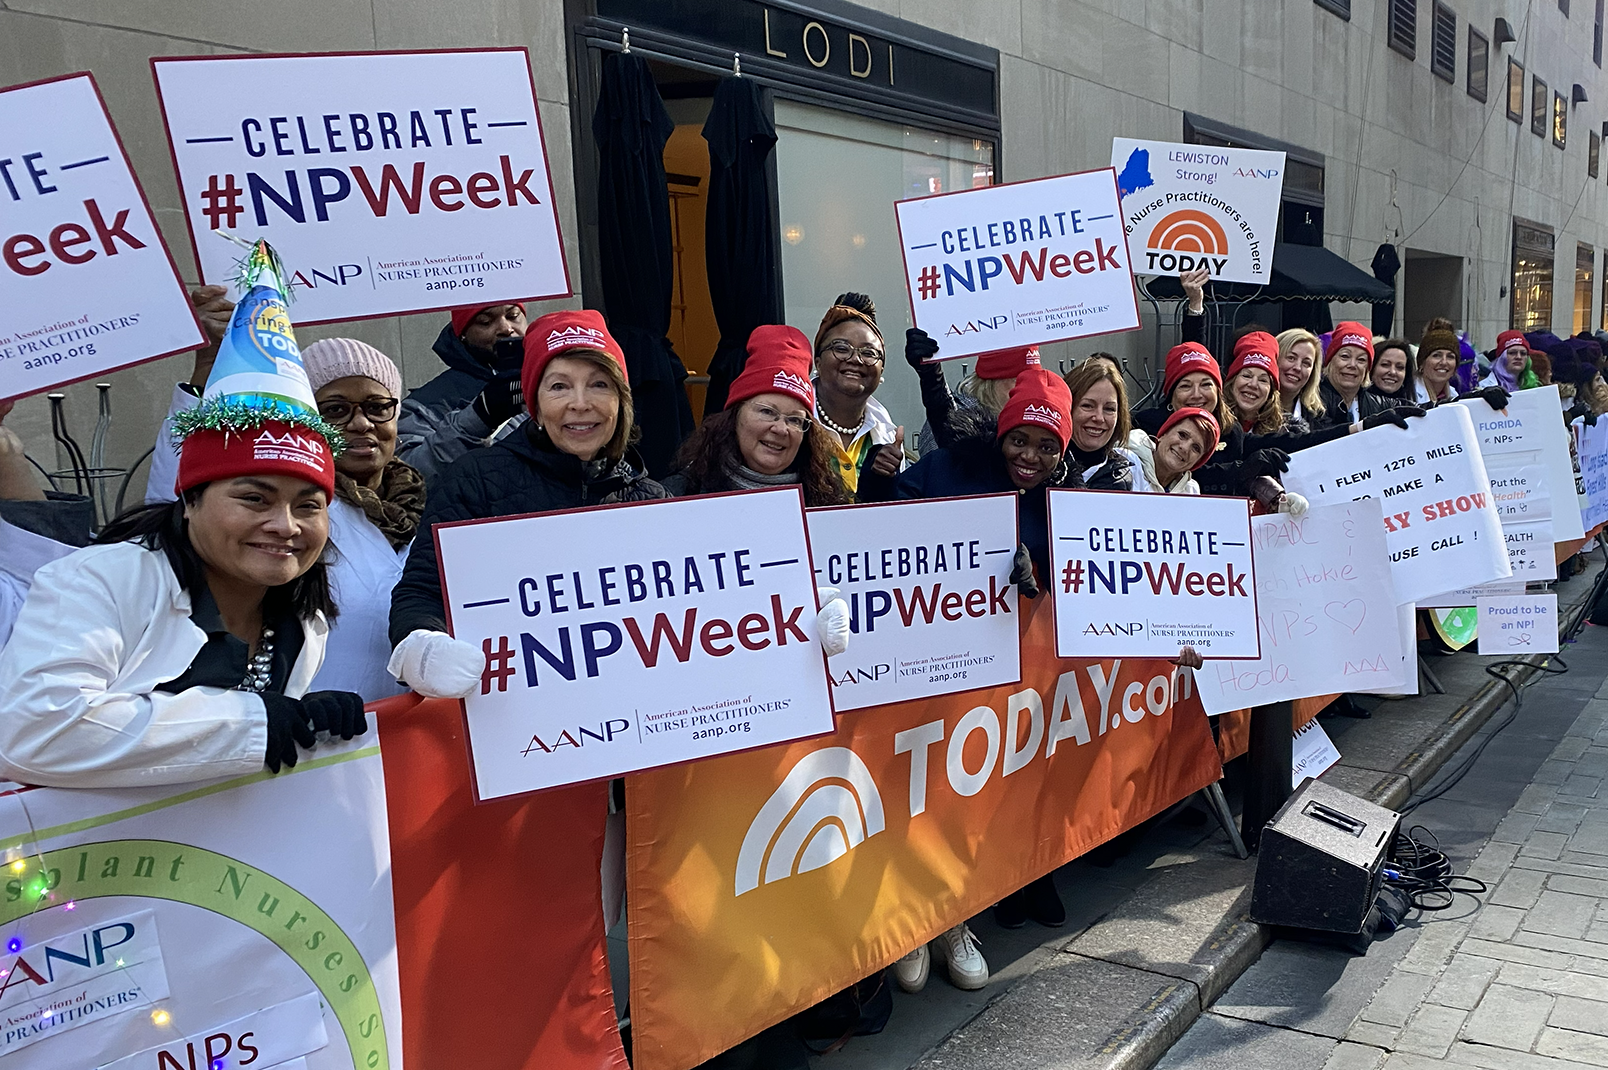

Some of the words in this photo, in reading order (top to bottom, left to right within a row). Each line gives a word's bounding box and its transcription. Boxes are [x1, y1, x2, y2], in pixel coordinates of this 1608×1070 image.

[764, 8, 894, 86] LODI
[241, 108, 483, 158] CELEBRATE
[1168, 151, 1230, 166] LEWISTON
[1175, 169, 1218, 185] Strong!
[1232, 168, 1279, 180] AANP
[201, 155, 541, 230] #NPWeek
[940, 209, 1085, 255] CELEBRATE
[1130, 197, 1164, 226] Nurse
[1166, 191, 1242, 222] Practitioners
[1239, 220, 1255, 240] are
[1250, 241, 1263, 275] here!
[376, 258, 421, 270] American
[423, 253, 470, 265] Association
[473, 252, 485, 261] of
[917, 237, 1122, 301] #NPWeek
[1145, 252, 1229, 276] TODAY
[286, 264, 363, 289] ANP
[378, 267, 422, 282] NURSE
[426, 276, 485, 291] aanp.org
[1016, 310, 1043, 319] American
[1045, 303, 1076, 314] Association
[1016, 316, 1043, 326] NURSE
[14, 319, 76, 342] Association
[78, 314, 89, 325] of
[546, 326, 605, 342] AANP
[945, 315, 1008, 337] AANP
[1045, 318, 1083, 331] aanp.org
[23, 342, 97, 370] aanp.org
[1024, 403, 1062, 420] AANP
[1479, 418, 1523, 431] FLORIDA
[253, 430, 324, 454] AANP
[1494, 435, 1513, 444] NPs
[1319, 484, 1325, 493] I
[1335, 469, 1372, 488] FLEW
[1383, 455, 1416, 473] 1276
[1426, 443, 1464, 460] MILES
[1383, 478, 1424, 498] MAKE
[1435, 473, 1444, 483] A
[1490, 478, 1508, 488] Put
[1510, 477, 1527, 486] the
[1422, 492, 1487, 522] SHOW
[1507, 505, 1516, 514] in
[1088, 527, 1219, 556] CELEBRATE
[1431, 534, 1464, 551] CALL
[828, 540, 981, 585] CELEBRATE
[518, 549, 756, 618] CELEBRATE
[1061, 559, 1248, 597] #NPWeek
[1294, 564, 1358, 588] Hokie
[1488, 605, 1519, 615] Proud
[1521, 605, 1532, 615] to
[1534, 605, 1547, 615] be
[1082, 622, 1143, 636] AANP
[1501, 622, 1514, 630] an
[1516, 620, 1535, 629] NP!
[480, 593, 810, 696] #NPWeek
[900, 658, 929, 667] American
[930, 652, 963, 663] Association
[900, 666, 928, 677] NURSE
[929, 669, 968, 683] aanp.org
[1215, 655, 1295, 697] Hoda
[643, 708, 689, 722] American
[690, 700, 737, 714] Association
[742, 695, 752, 705] of
[520, 718, 630, 758] AANP
[645, 718, 690, 736] NURSE
[691, 720, 752, 741] aanp.org
[894, 659, 1193, 818] TODAY.com
[213, 864, 359, 994] Nurses
[76, 991, 88, 1003] of
[157, 1030, 260, 1070] NPs
